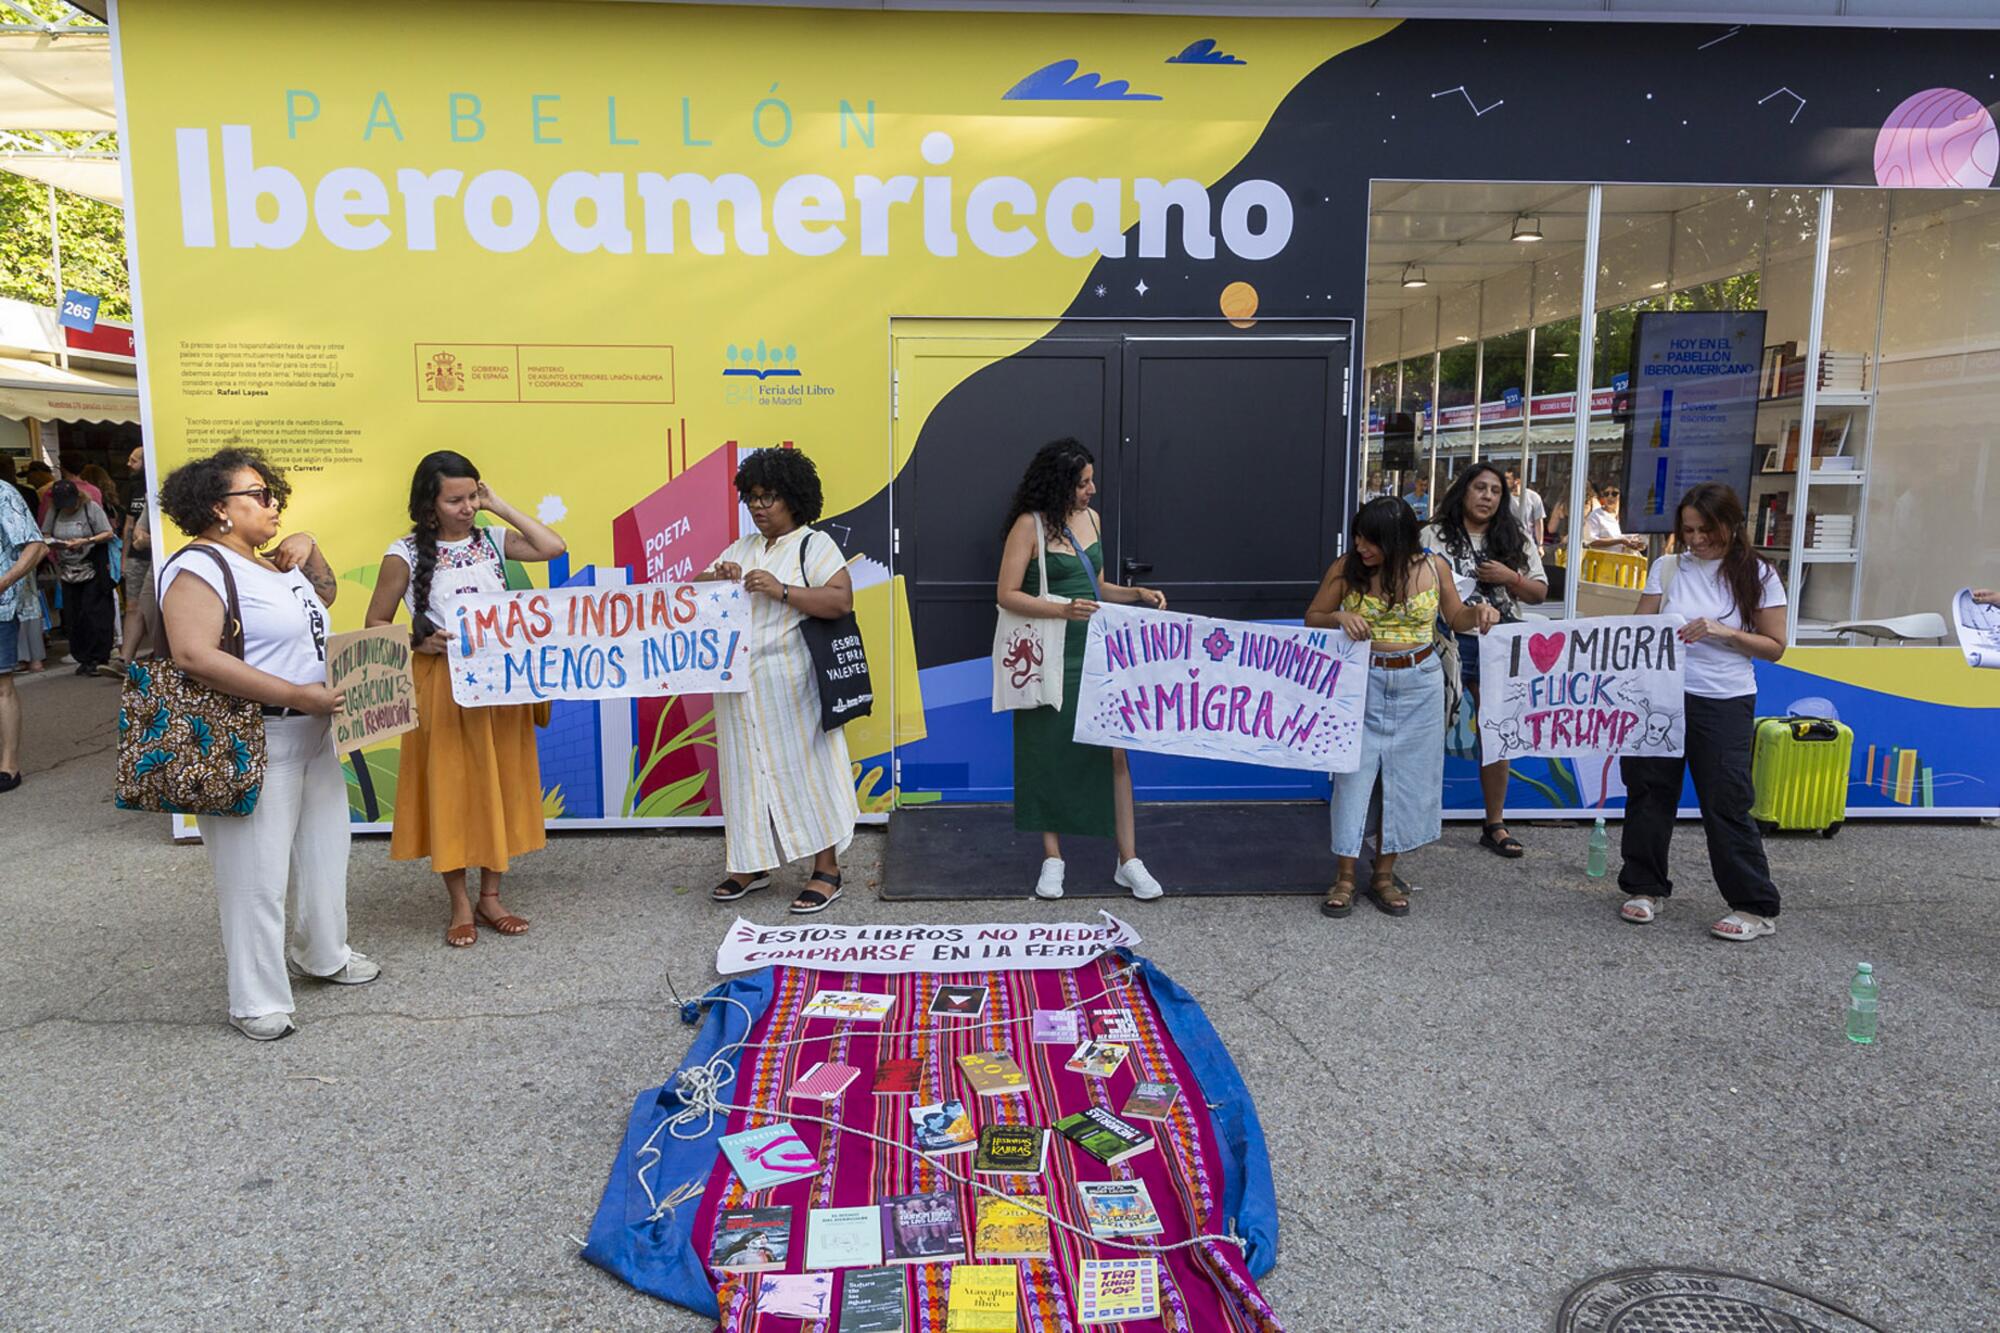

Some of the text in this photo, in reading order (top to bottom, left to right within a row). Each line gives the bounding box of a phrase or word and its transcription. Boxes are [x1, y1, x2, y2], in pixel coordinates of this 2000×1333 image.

[286, 83, 877, 149] PABELLÓN
[175, 124, 1295, 261] Iberoamericano
[64, 301, 92, 320] 265
[1670, 339, 1733, 350] HOY EN EL
[483, 372, 509, 380] ESPAÑA
[1644, 363, 1754, 377] IBEROAMERICANO
[243, 389, 269, 397] Lapesa
[759, 385, 835, 396] Feria del Libro
[772, 397, 802, 405] Madrid
[646, 516, 691, 558] POETA
[647, 552, 665, 578] EN
[567, 585, 698, 639] INDIAS
[504, 628, 741, 698] MENOS INDIS!
[1509, 625, 1676, 678] I MIGRA
[1238, 633, 1343, 699] INDÓMITA
[344, 671, 394, 717] IGRACIÓN
[1528, 672, 1617, 708] FUCK
[1524, 708, 1640, 752] TRUMP
[756, 925, 848, 945] ESTOS
[858, 926, 964, 944] LIBROS
[976, 928, 1018, 943] NO
[745, 944, 915, 963] COMPRARSE
[931, 944, 971, 962] EN
[982, 943, 1012, 959] LA
[1100, 1269, 1136, 1280] TRA
[1100, 1286, 1136, 1297] POP
